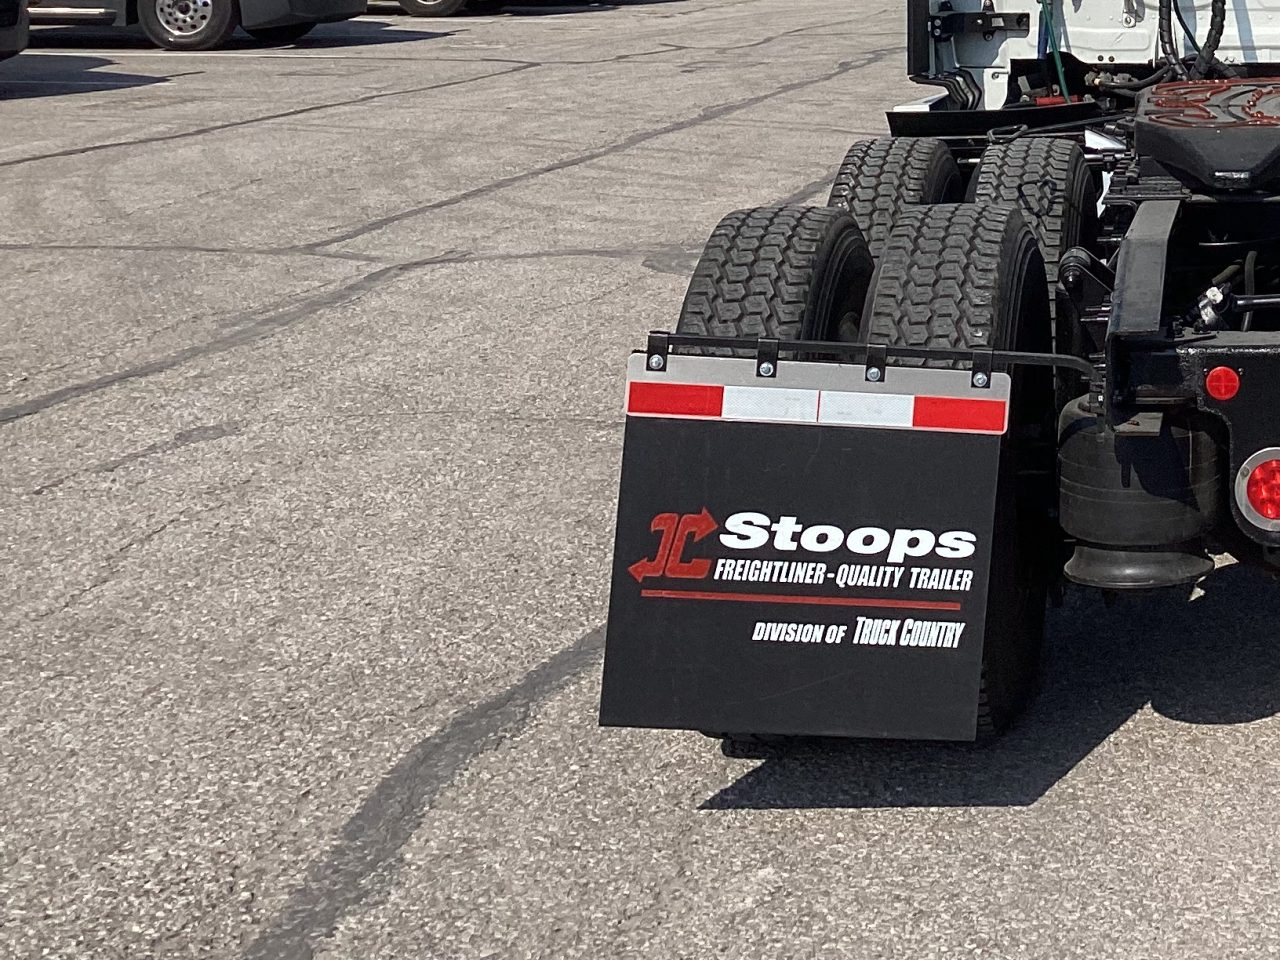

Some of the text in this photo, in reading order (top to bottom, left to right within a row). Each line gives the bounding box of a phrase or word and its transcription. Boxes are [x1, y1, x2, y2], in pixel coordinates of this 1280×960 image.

[719, 511, 977, 564] Stoops
[909, 567, 974, 592] TRAILER
[751, 616, 966, 649] DIVISION OF TRUCK COUNTRY
